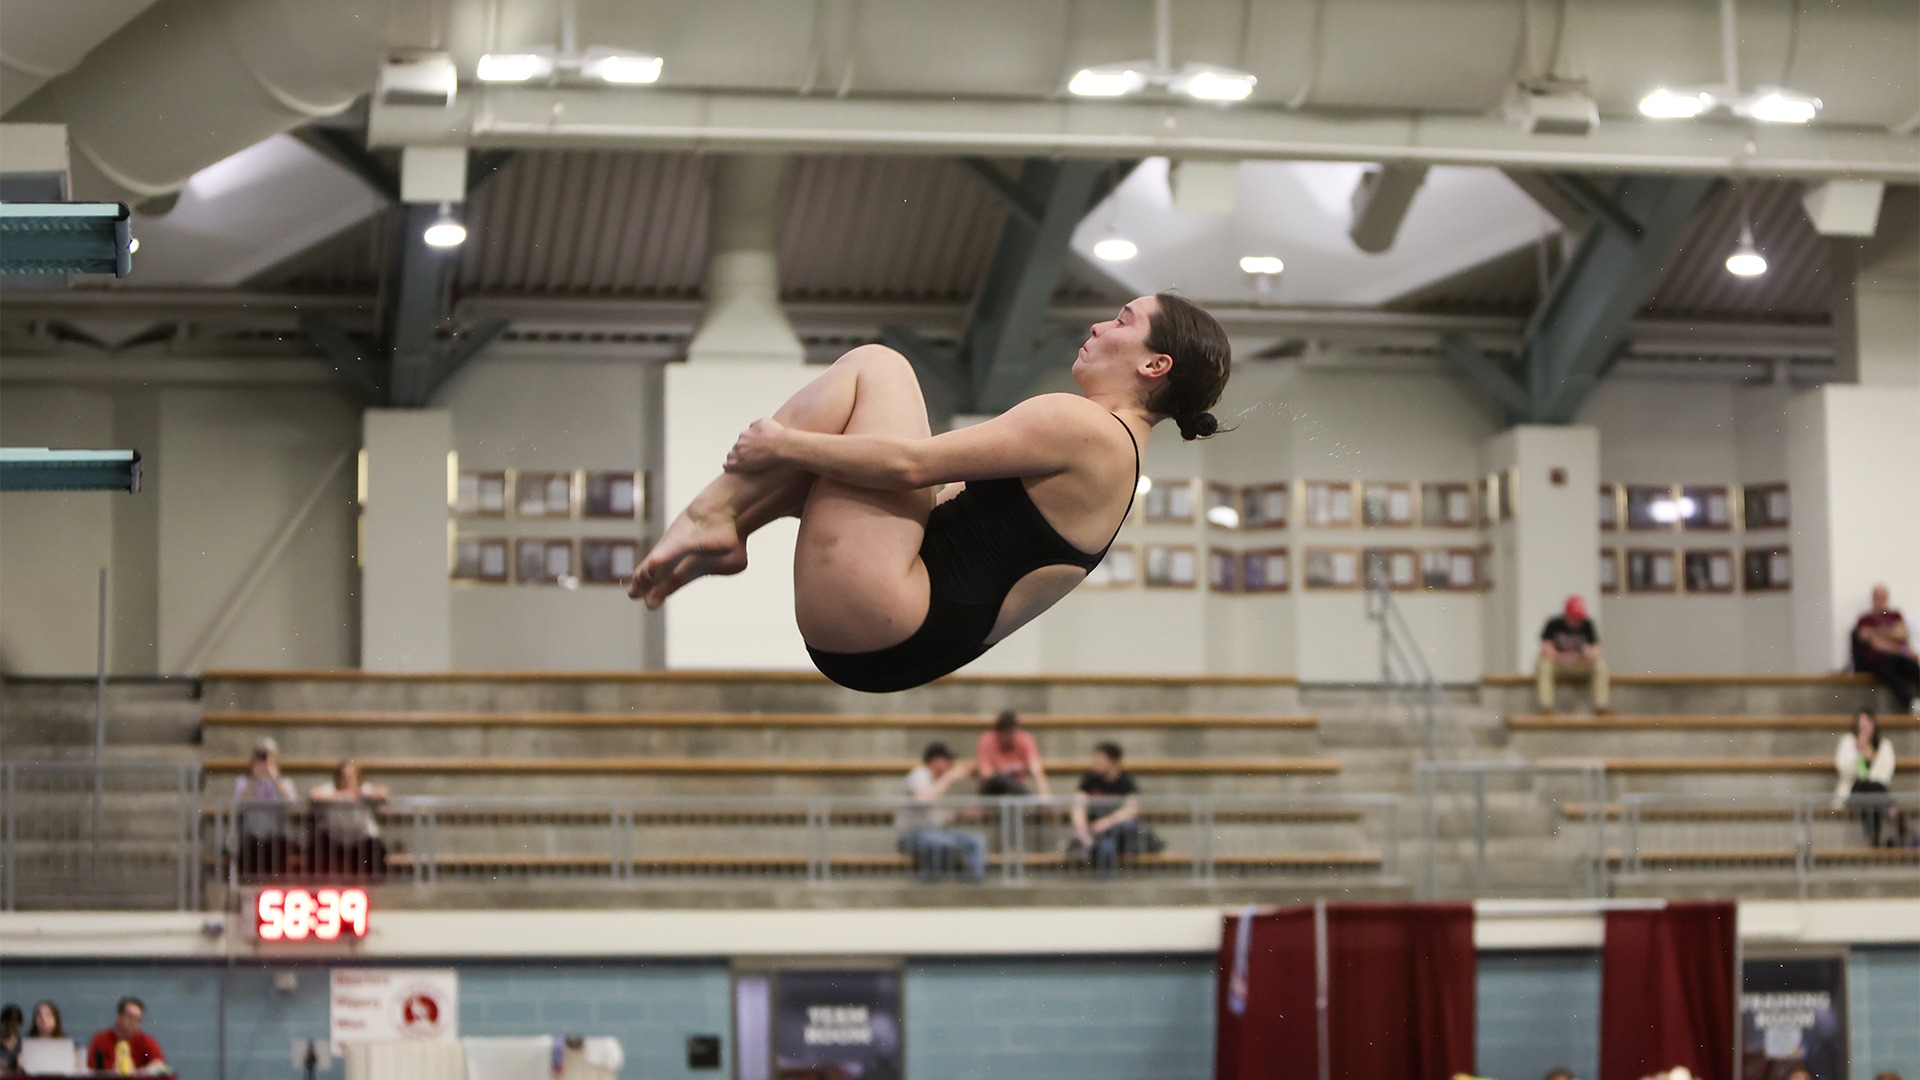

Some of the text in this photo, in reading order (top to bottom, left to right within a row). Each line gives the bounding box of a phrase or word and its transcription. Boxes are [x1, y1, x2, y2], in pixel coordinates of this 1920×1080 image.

[258, 889, 369, 940] 58:39
[807, 1006, 869, 1024] TEAM
[804, 1026, 872, 1045] ROOM
